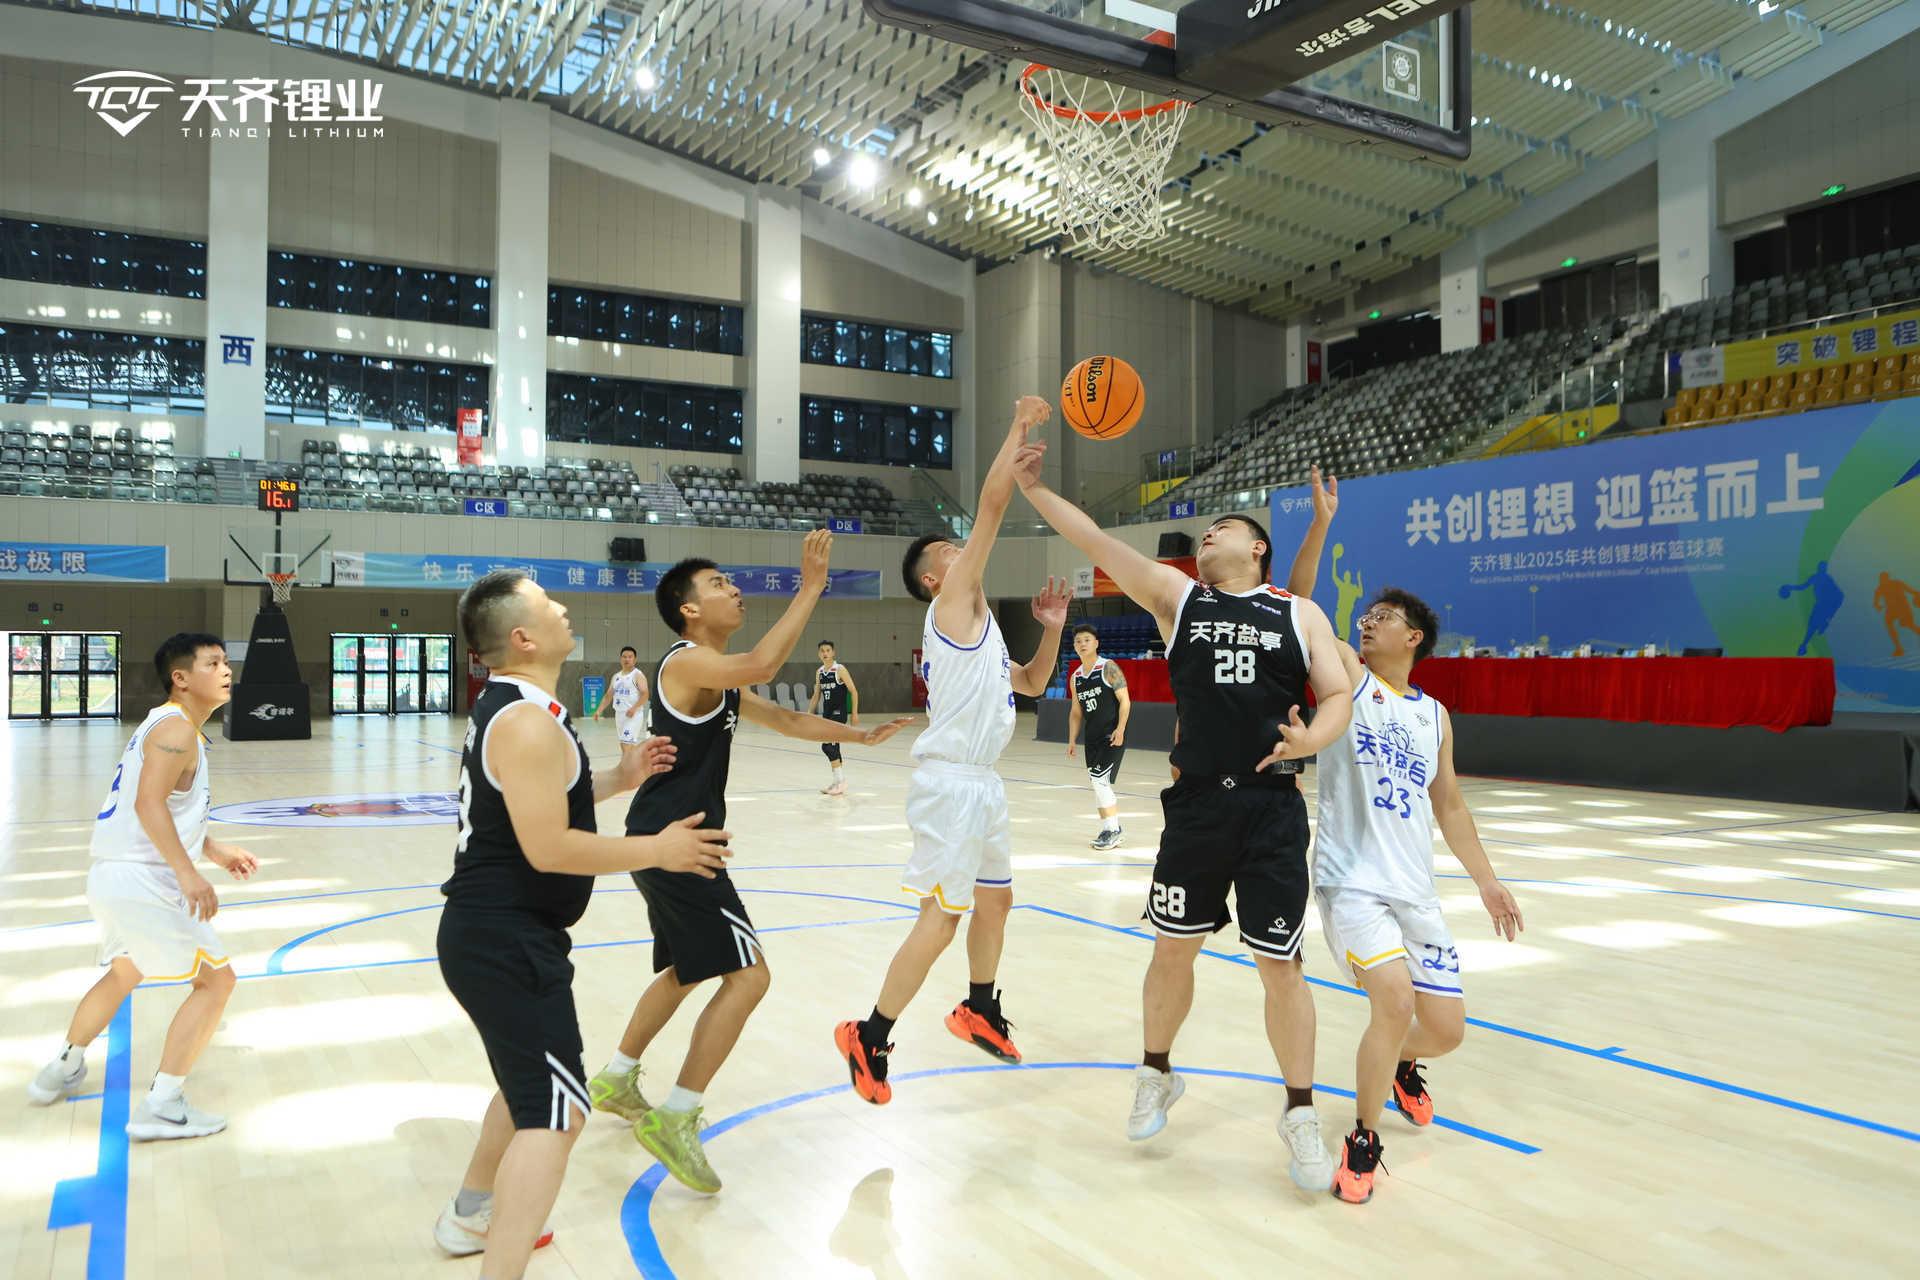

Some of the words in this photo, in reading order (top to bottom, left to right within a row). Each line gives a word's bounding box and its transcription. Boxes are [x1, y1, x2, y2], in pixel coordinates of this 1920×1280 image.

[219, 334, 255, 366] 西
[1776, 319, 1920, 368] 突破锂程
[1086, 356, 1106, 403] Wilson
[474, 501, 496, 514] C区
[1404, 480, 1577, 547] 共创锂想
[1594, 452, 1825, 530] 迎篮而上
[836, 519, 854, 531] D区
[0, 548, 86, 573] 战极限
[1469, 537, 1725, 573] 天齐锂业2025年共创锂想杯篮球赛
[567, 566, 664, 588] 健康生
[1189, 620, 1283, 652] 天齐盐亭
[1214, 649, 1256, 685] 28
[1085, 697, 1098, 713] 30
[1373, 776, 1412, 819] 23
[1152, 881, 1187, 919] 28
